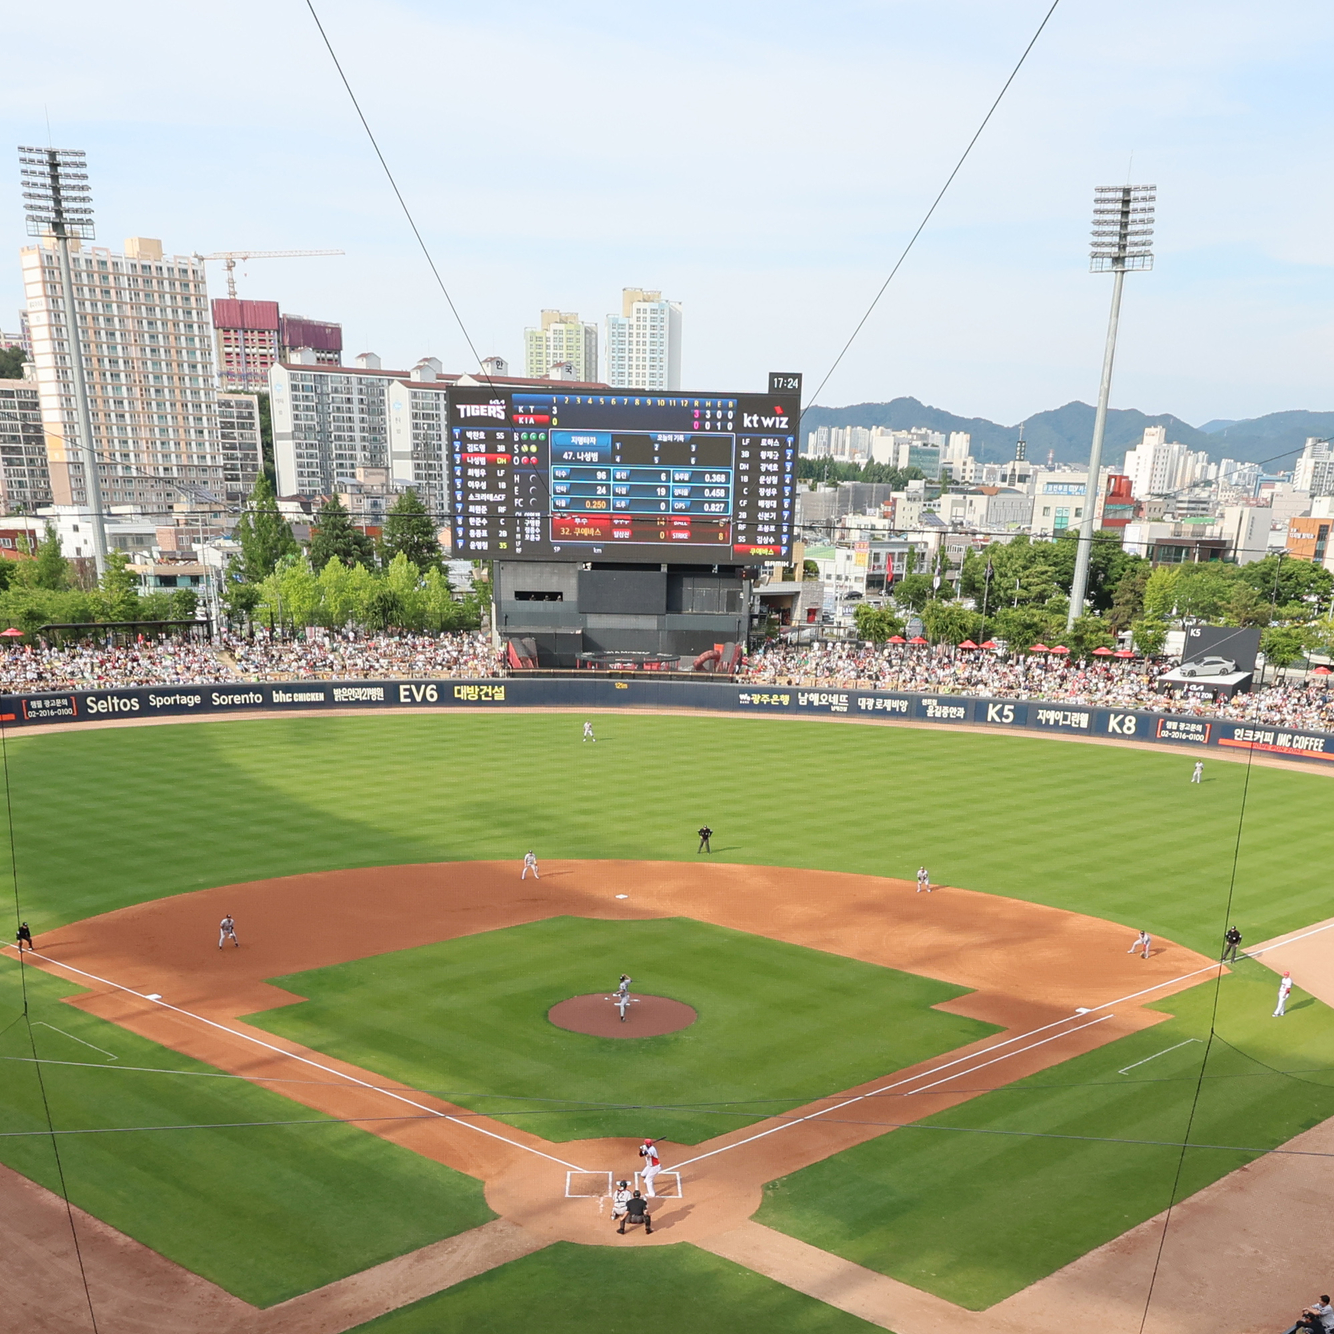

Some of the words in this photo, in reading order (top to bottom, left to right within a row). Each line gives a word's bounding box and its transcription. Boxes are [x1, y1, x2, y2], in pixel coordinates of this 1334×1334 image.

[495, 360, 504, 370] 안
[773, 377, 799, 389] 17:24
[455, 404, 507, 420] TIGERS
[743, 413, 760, 428] kt
[761, 411, 789, 429] wiz
[562, 452, 575, 461] 47.
[577, 451, 599, 462] 나성범
[596, 471, 607, 480] 96
[704, 473, 726, 483] 0.368
[596, 485, 607, 495] 24
[656, 487, 667, 496] 19
[704, 488, 726, 498] 0.458
[585, 500, 607, 509] 0.250
[673, 502, 686, 510] OPS
[703, 502, 725, 512] 0.827
[560, 527, 572, 536] 32.
[498, 541, 508, 550] 35
[1190, 628, 1202, 637] K5
[211, 692, 263, 706] Sorento
[272, 690, 293, 703] bhc
[293, 691, 325, 703] CHICKEN
[332, 687, 385, 702] 밝은안과21병원
[398, 684, 439, 703] EV6
[453, 685, 506, 701] 대방건설
[750, 693, 790, 706] 광주은행
[797, 691, 849, 707] 남해오네뜨
[85, 695, 140, 715] Seltos
[148, 692, 202, 709] Sportage
[27, 707, 74, 719] 02-2016-0100
[926, 704, 965, 719] 윤길중안과
[986, 703, 1015, 724] K5
[1036, 708, 1090, 729] 지에이그린웰
[1107, 713, 1137, 735] K8
[1160, 730, 1205, 743] 02-2016-0100
[1233, 728, 1275, 745] 인크커피
[1291, 734, 1326, 752] COFFEE
